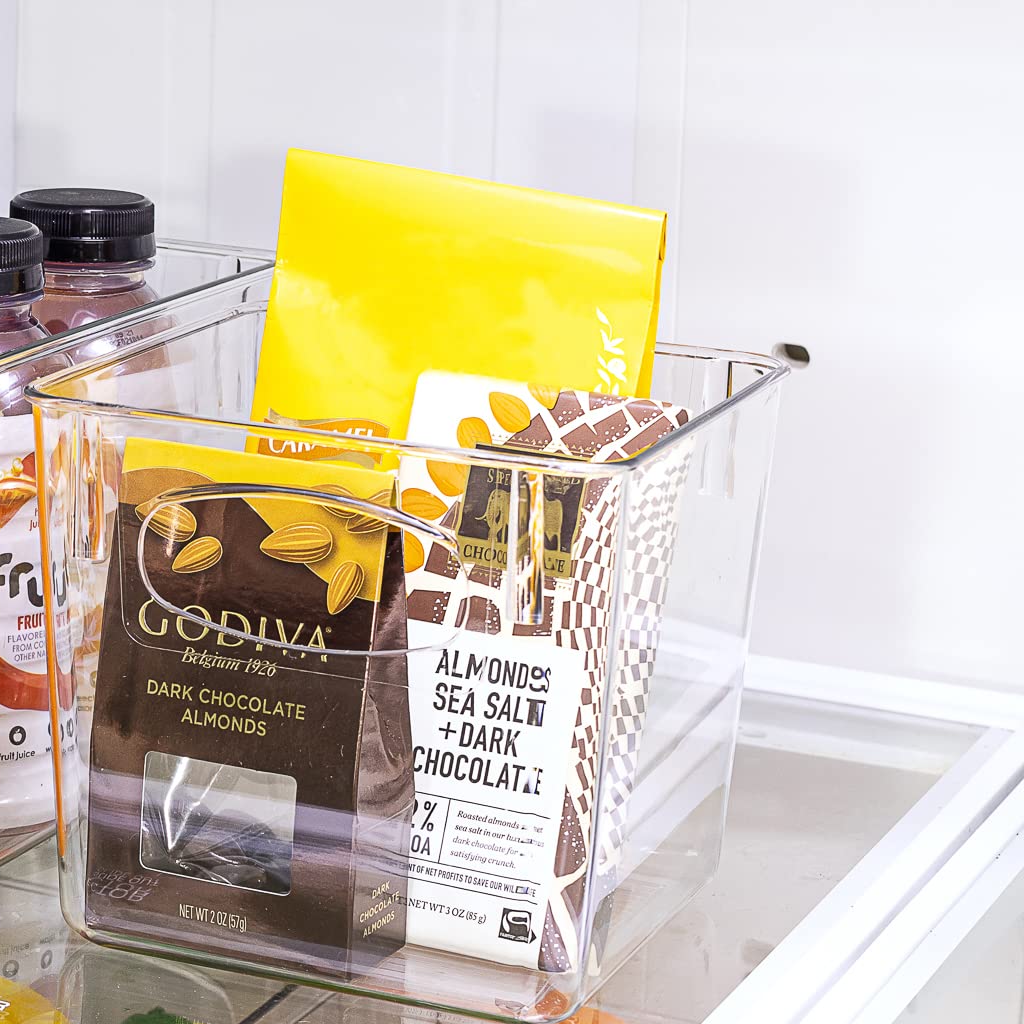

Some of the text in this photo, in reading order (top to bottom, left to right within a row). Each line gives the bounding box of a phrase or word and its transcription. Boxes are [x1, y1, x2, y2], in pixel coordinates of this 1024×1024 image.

[7, 631, 45, 644] FLAVORE
[138, 595, 329, 663] GODIVA
[12, 643, 33, 653] FROM
[14, 651, 36, 663] OTHER
[181, 646, 277, 678] Belgium 1926
[146, 679, 307, 721] DARK CHOCOLATE
[433, 682, 476, 717] SEA
[181, 708, 267, 736] ALMONDS
[16, 750, 36, 761] juice
[457, 810, 488, 823] Roasted
[488, 816, 520, 830] almonds
[455, 824, 506, 840] sea salt in our
[452, 836, 471, 846] dark
[470, 840, 506, 853] chocolate
[504, 846, 519, 855] for
[450, 849, 517, 869] satisfying crunch.
[417, 864, 426, 874] OF
[426, 867, 438, 878] NET
[437, 869, 464, 883] PROFITS
[464, 874, 473, 885] TO
[473, 877, 489, 889] SAVE
[489, 880, 503, 891] OUR
[371, 881, 391, 900] DARK
[359, 890, 400, 923] CHOCOLATE
[408, 898, 431, 910] NET
[429, 902, 445, 914] WT
[445, 906, 451, 915] 3
[451, 907, 466, 919] OZ
[179, 903, 247, 933] NET WT 2 OZ (57g)
[362, 910, 396, 939] ALMONDS
